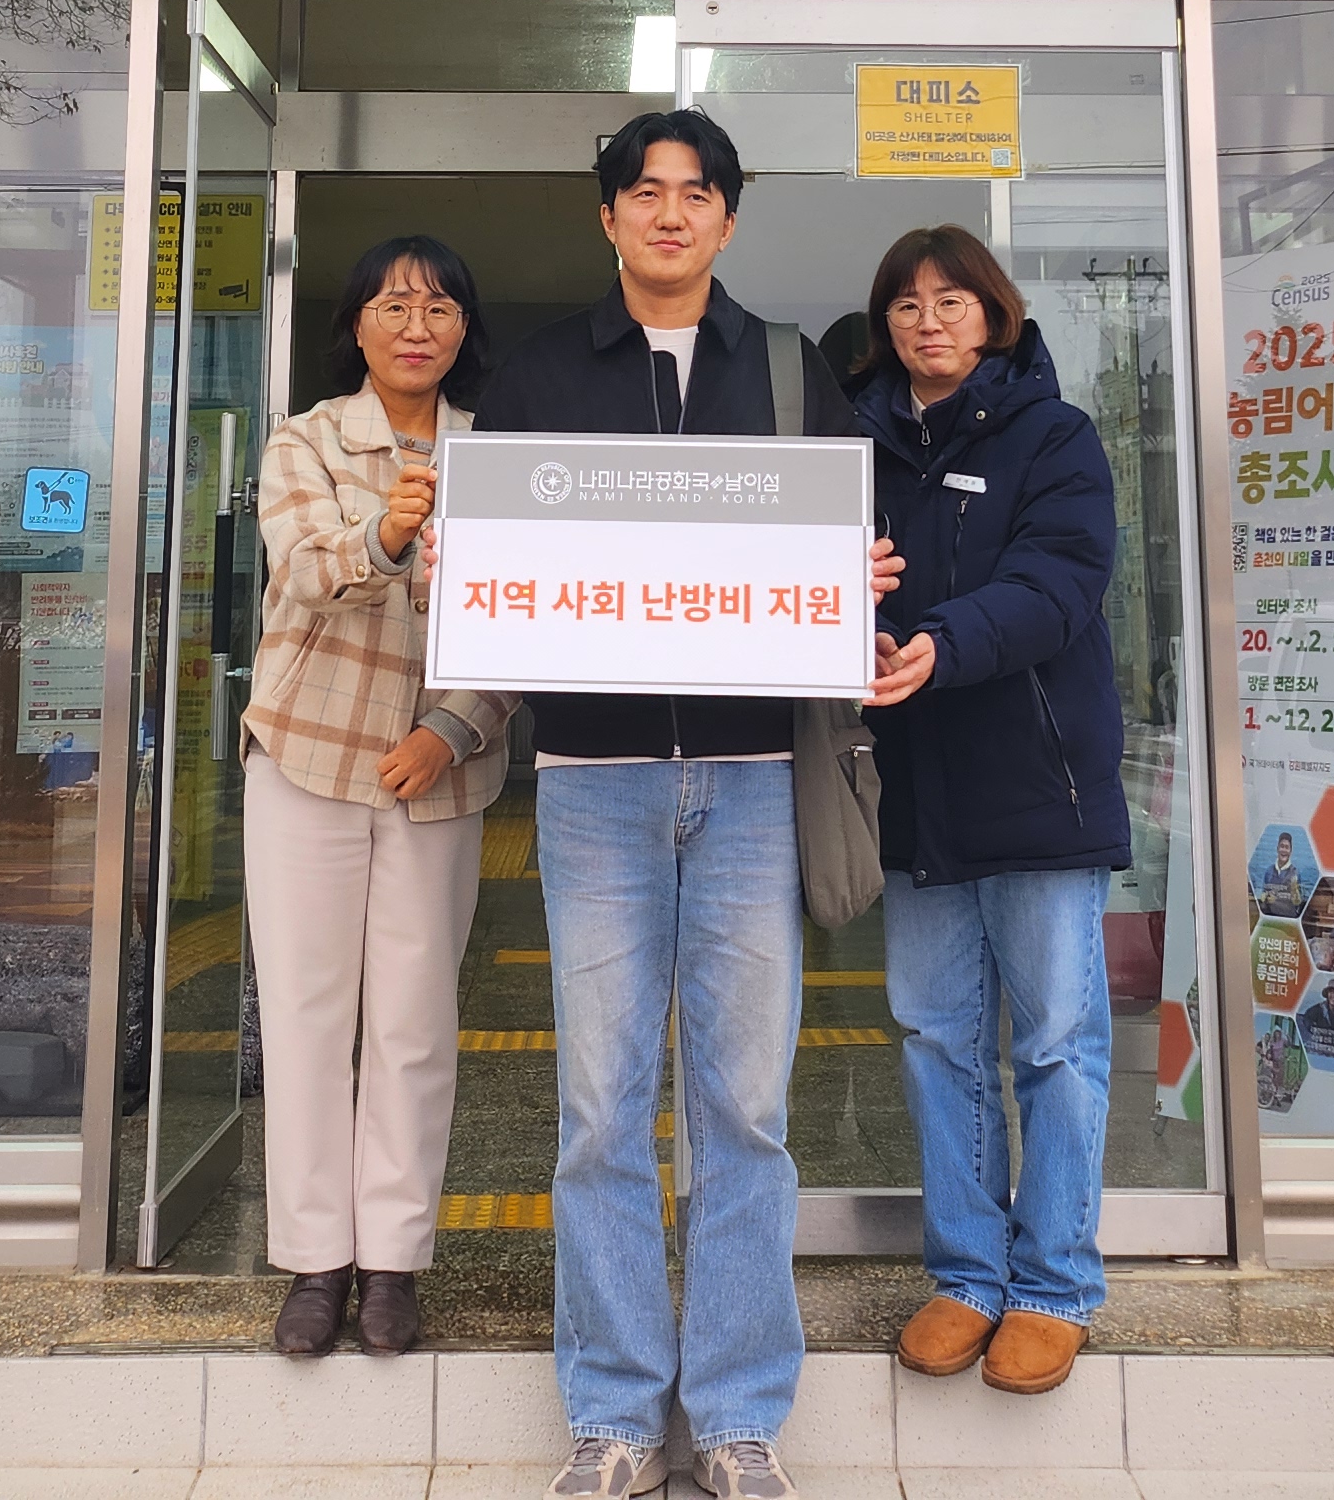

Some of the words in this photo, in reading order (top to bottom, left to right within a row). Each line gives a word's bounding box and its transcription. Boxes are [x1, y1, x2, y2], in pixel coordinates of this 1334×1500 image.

[895, 80, 980, 104] 대피소
[904, 112, 973, 123] SHELTER
[865, 131, 897, 143] 이곳은
[899, 132, 932, 143] 산사태
[227, 202, 252, 217] 안내
[1301, 273, 1331, 286] 2025
[1271, 284, 1330, 307] Census
[19, 360, 45, 374] 안내
[578, 469, 711, 493] 나미나라공화국
[723, 471, 780, 493] 남이섬
[578, 491, 625, 502] NAMI
[636, 492, 702, 504] ISLAND
[722, 494, 780, 505] KOREA
[1255, 527, 1276, 543] 책임
[1279, 527, 1302, 543] 있는
[1305, 526, 1317, 543] 한
[1253, 552, 1284, 567] 춘천의
[1287, 550, 1322, 567] 내일을
[463, 578, 537, 619] 지역
[551, 580, 625, 621] 사회
[642, 582, 751, 624] 난방비
[768, 584, 842, 625] 지원
[1256, 598, 1290, 615] 인터넷
[1292, 598, 1318, 615] 조사
[1247, 675, 1270, 691] 방문
[1284, 708, 1316, 733] 12.
